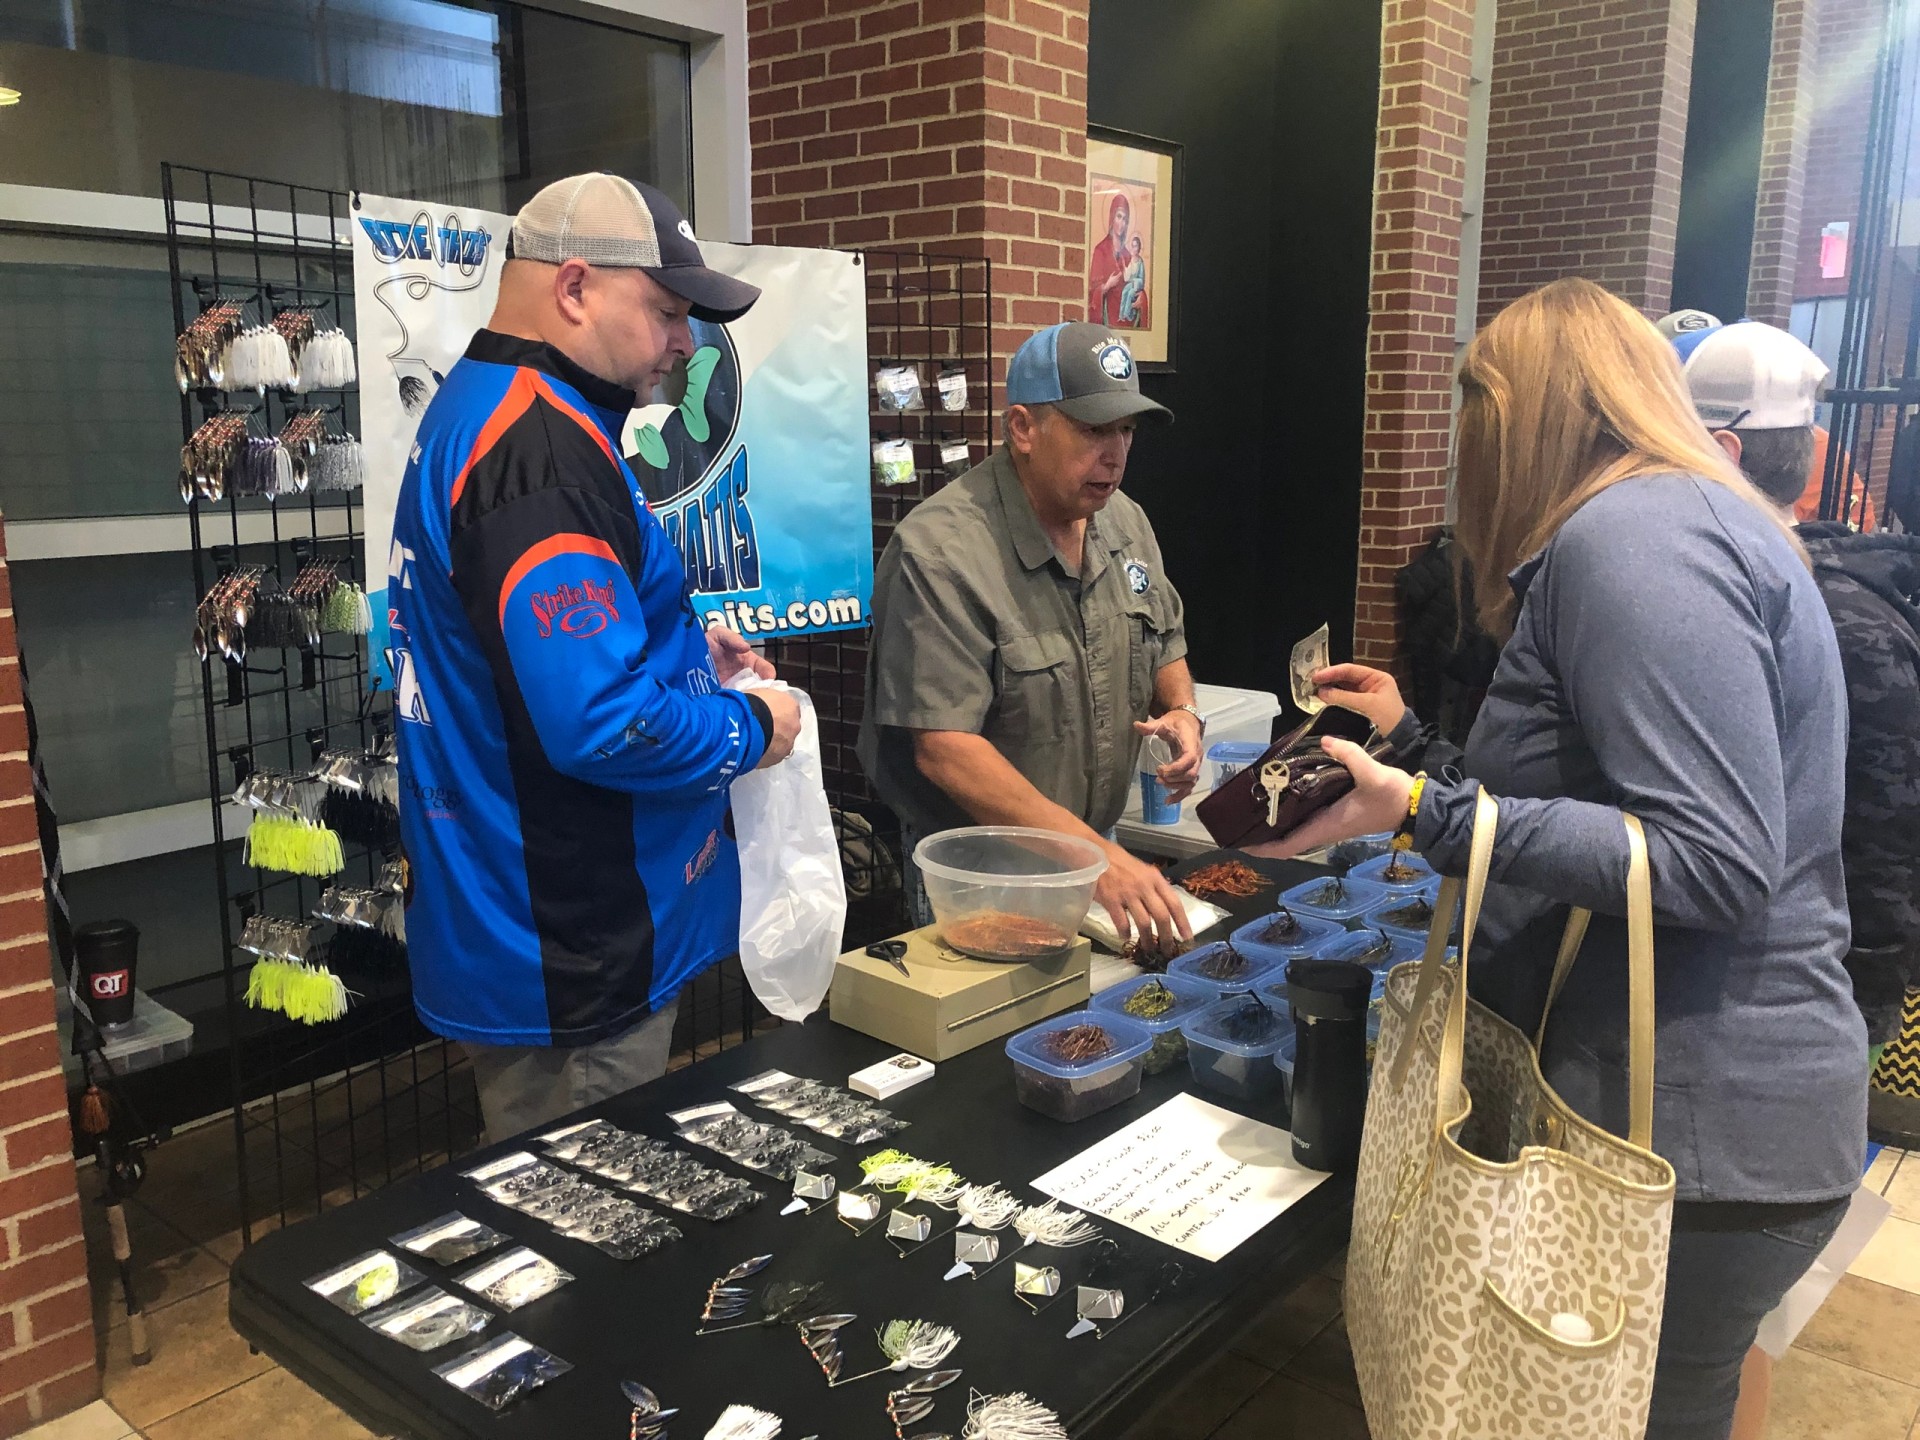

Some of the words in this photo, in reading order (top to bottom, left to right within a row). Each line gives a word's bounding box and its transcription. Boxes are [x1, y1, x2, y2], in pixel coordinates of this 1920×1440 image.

[530, 583, 583, 638] Strike
[581, 578, 620, 623] King
[699, 597, 862, 636] aits.com
[94, 973, 123, 994] QT
